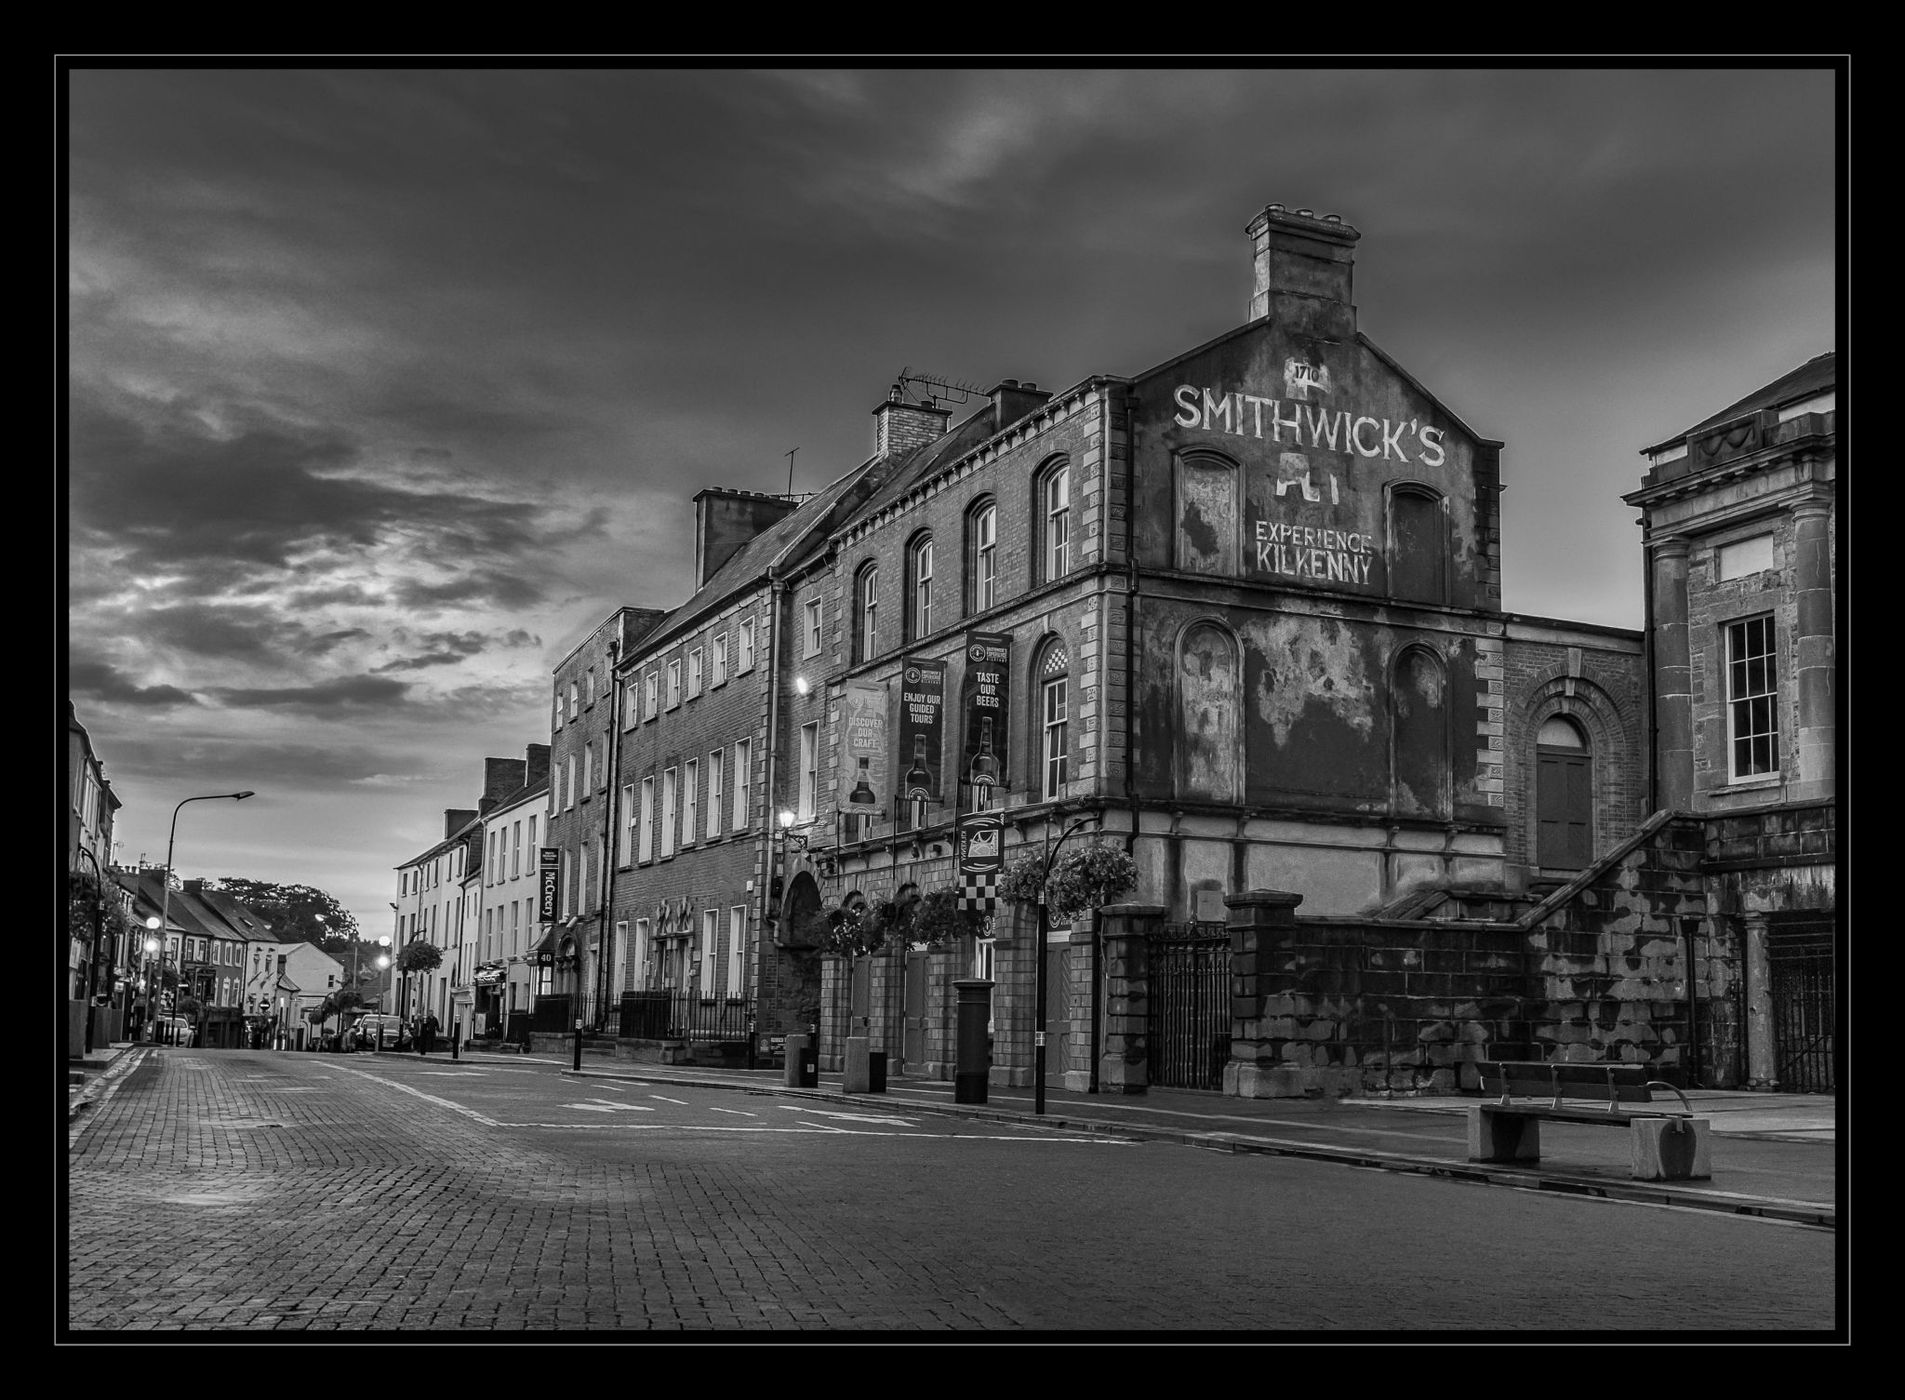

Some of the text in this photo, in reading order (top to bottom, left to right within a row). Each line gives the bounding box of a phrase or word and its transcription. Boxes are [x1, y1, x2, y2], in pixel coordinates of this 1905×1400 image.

[1295, 366, 1319, 382] 1710
[1173, 384, 1446, 467] SMITHWICK'S
[1256, 521, 1372, 554] EXPERIENCE
[1256, 542, 1373, 584] KILKENNY
[976, 672, 999, 684] TASTE
[980, 684, 996, 695] OUR
[904, 692, 940, 704] ENJOY OUR
[976, 695, 999, 707] BEERS
[909, 704, 934, 714] GUIDED
[849, 717, 883, 729] DISCOVER
[910, 714, 933, 724] TOURS
[857, 728, 873, 737] OUR
[853, 738, 876, 748] CRAFT
[542, 872, 556, 917] McCreery
[541, 954, 551, 962] 40
